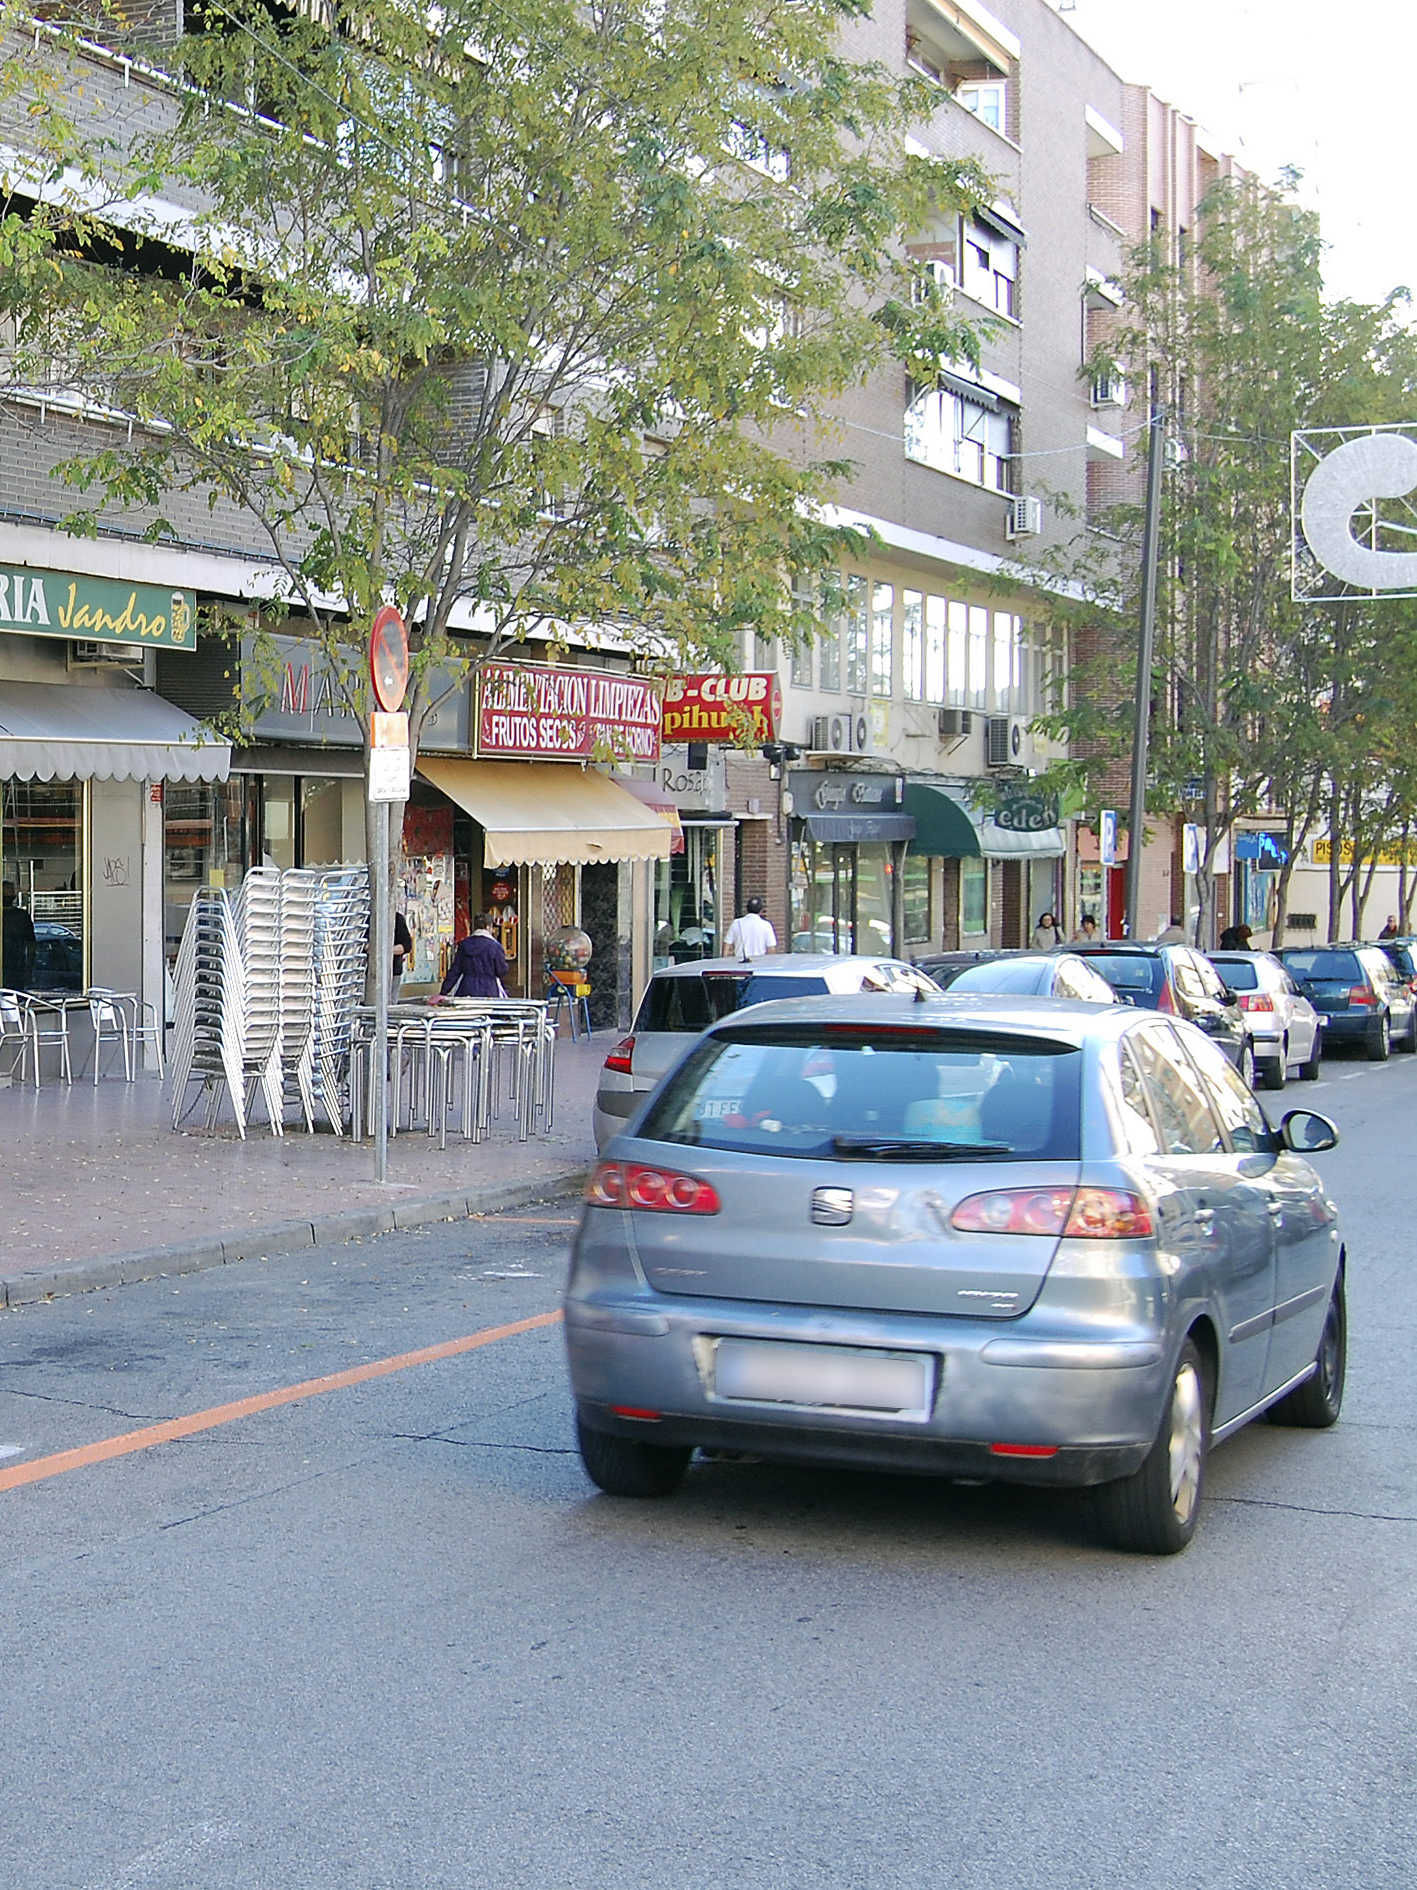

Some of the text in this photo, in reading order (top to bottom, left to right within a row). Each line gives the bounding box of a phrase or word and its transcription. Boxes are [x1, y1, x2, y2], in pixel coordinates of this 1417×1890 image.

[58, 582, 167, 637] Jandro
[589, 679, 661, 726] LIMPIEZAS
[491, 714, 537, 747] FRUTOS
[1316, 841, 1352, 856] PISS
